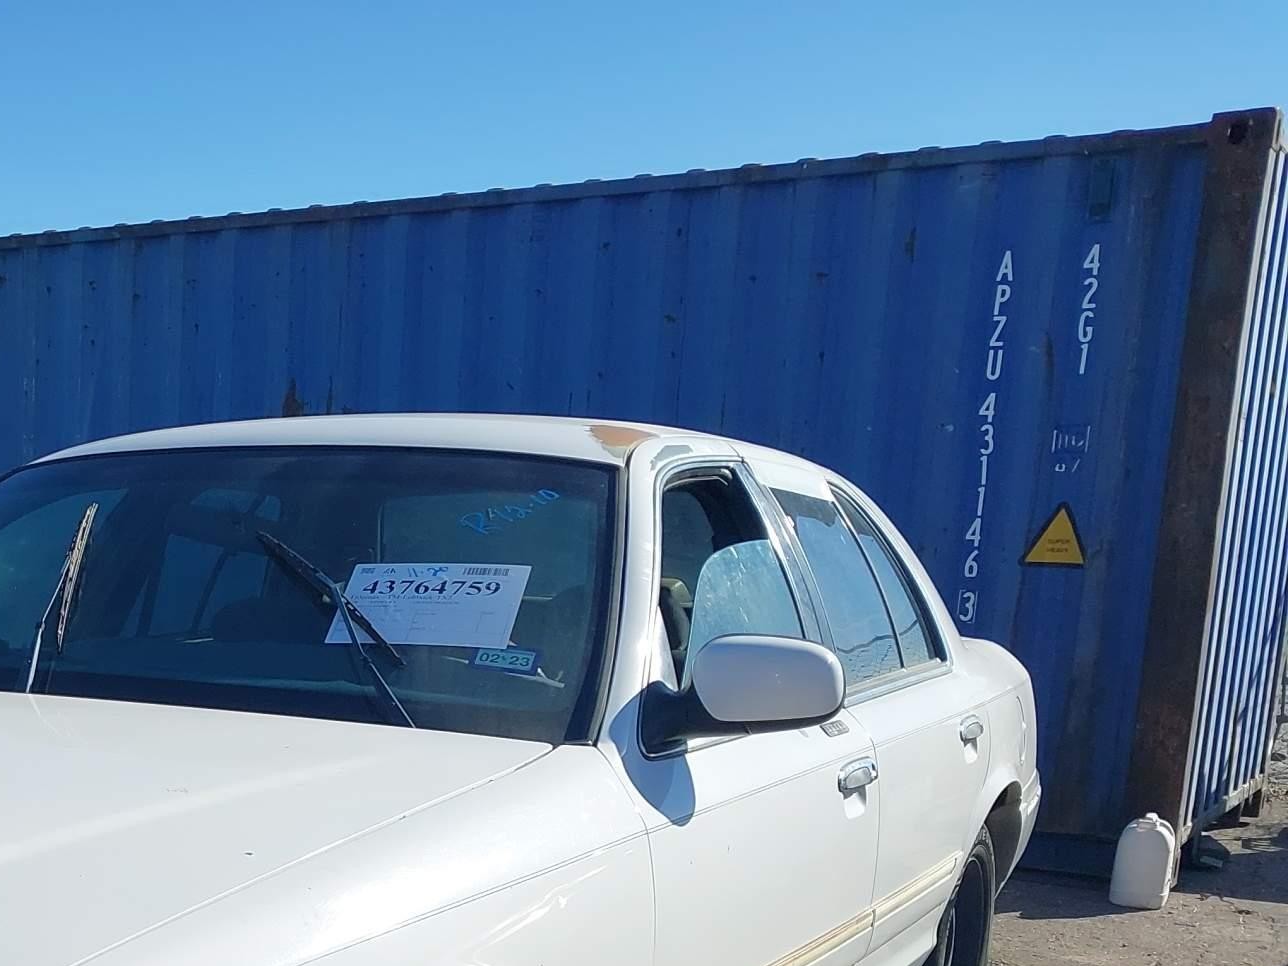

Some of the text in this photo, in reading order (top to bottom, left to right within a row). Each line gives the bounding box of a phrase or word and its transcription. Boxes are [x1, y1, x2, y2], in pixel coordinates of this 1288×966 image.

[986, 250, 1015, 381] APZU
[1077, 243, 1101, 376] 42G1
[363, 580, 502, 596] 43764759
[479, 652, 530, 667] 02 23
